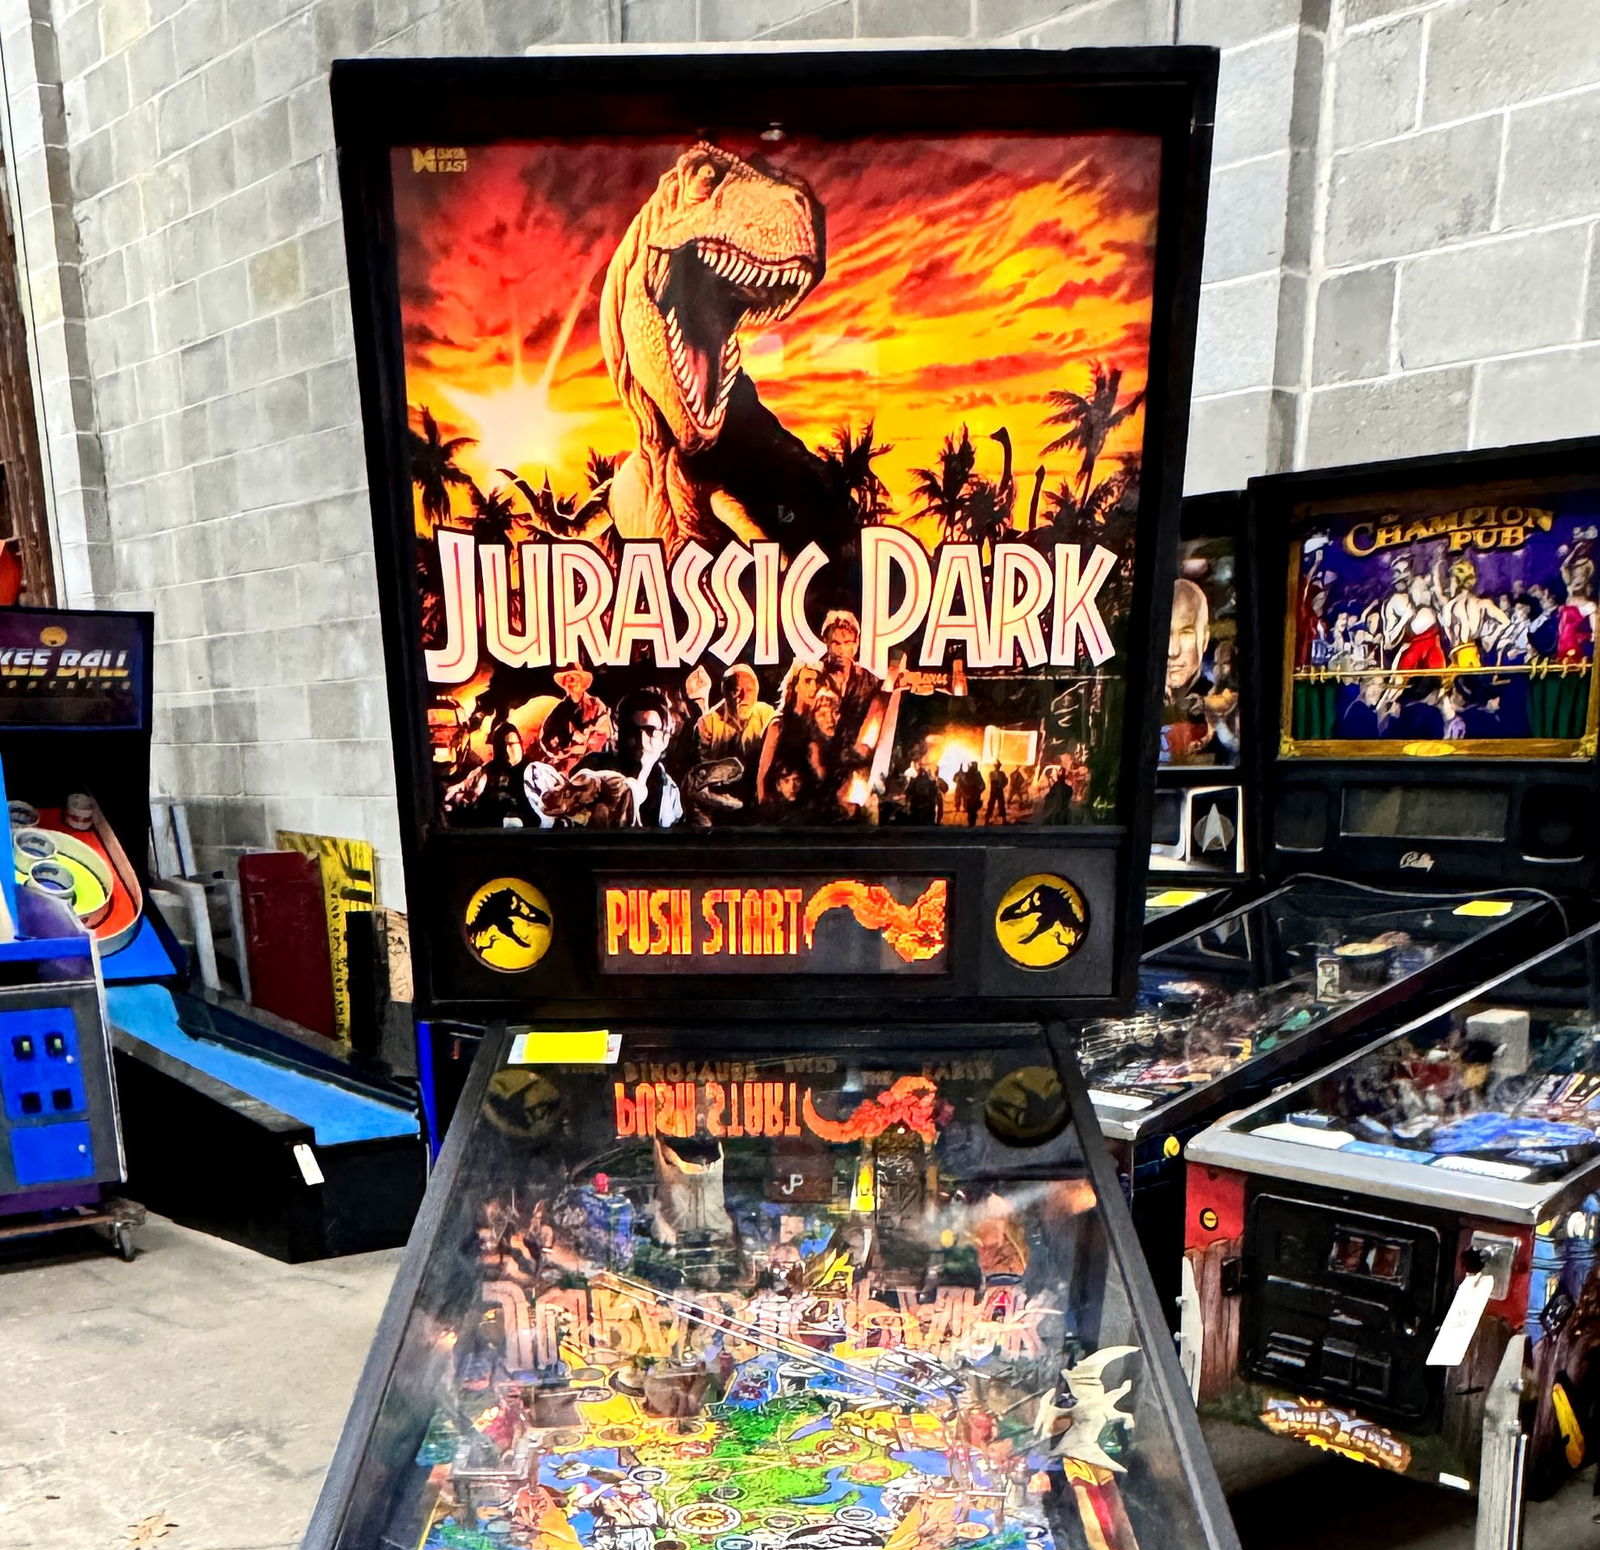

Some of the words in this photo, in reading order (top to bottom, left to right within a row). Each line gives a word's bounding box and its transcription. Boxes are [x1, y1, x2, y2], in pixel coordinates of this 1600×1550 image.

[1343, 506, 1554, 557] CHAMPION
[1450, 527, 1526, 551] PUB
[424, 530, 830, 683] JURASSIC
[860, 527, 1118, 680] PARK
[56, 649, 129, 679] BALL
[605, 889, 693, 955] PUSH
[701, 889, 803, 955] START
